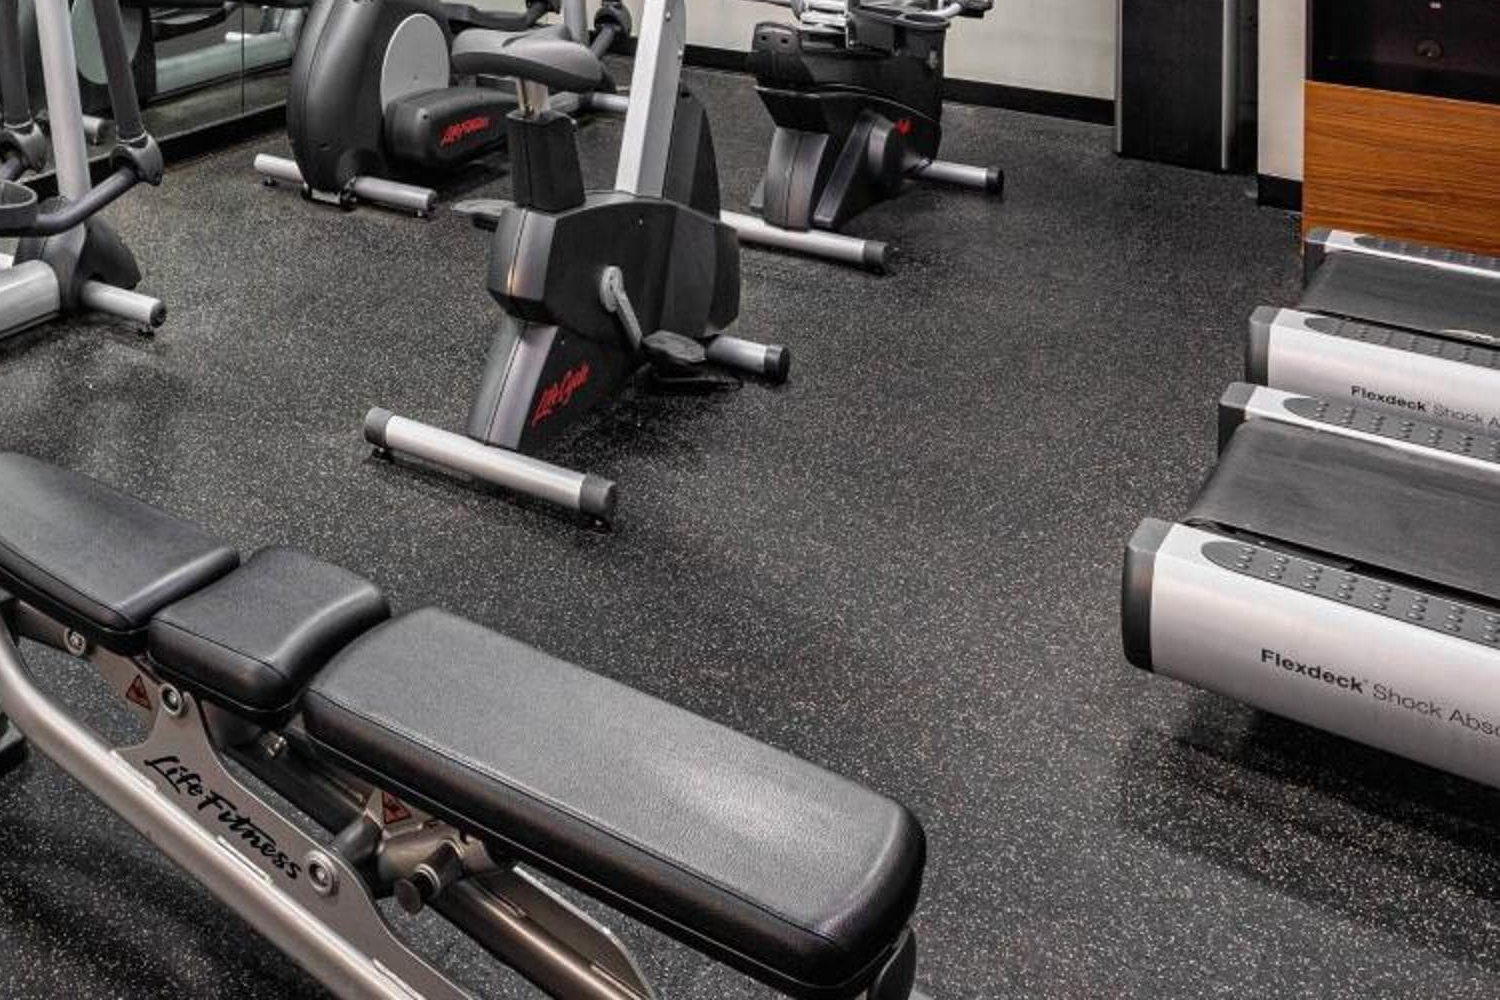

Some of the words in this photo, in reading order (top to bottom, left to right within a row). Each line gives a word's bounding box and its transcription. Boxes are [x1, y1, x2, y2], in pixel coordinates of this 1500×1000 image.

[1351, 385, 1426, 412] Flexdeck
[1261, 648, 1363, 694] Flexdeck
[1373, 683, 1443, 719] Shock
[143, 755, 203, 797] Life
[197, 789, 302, 880] Fitness
